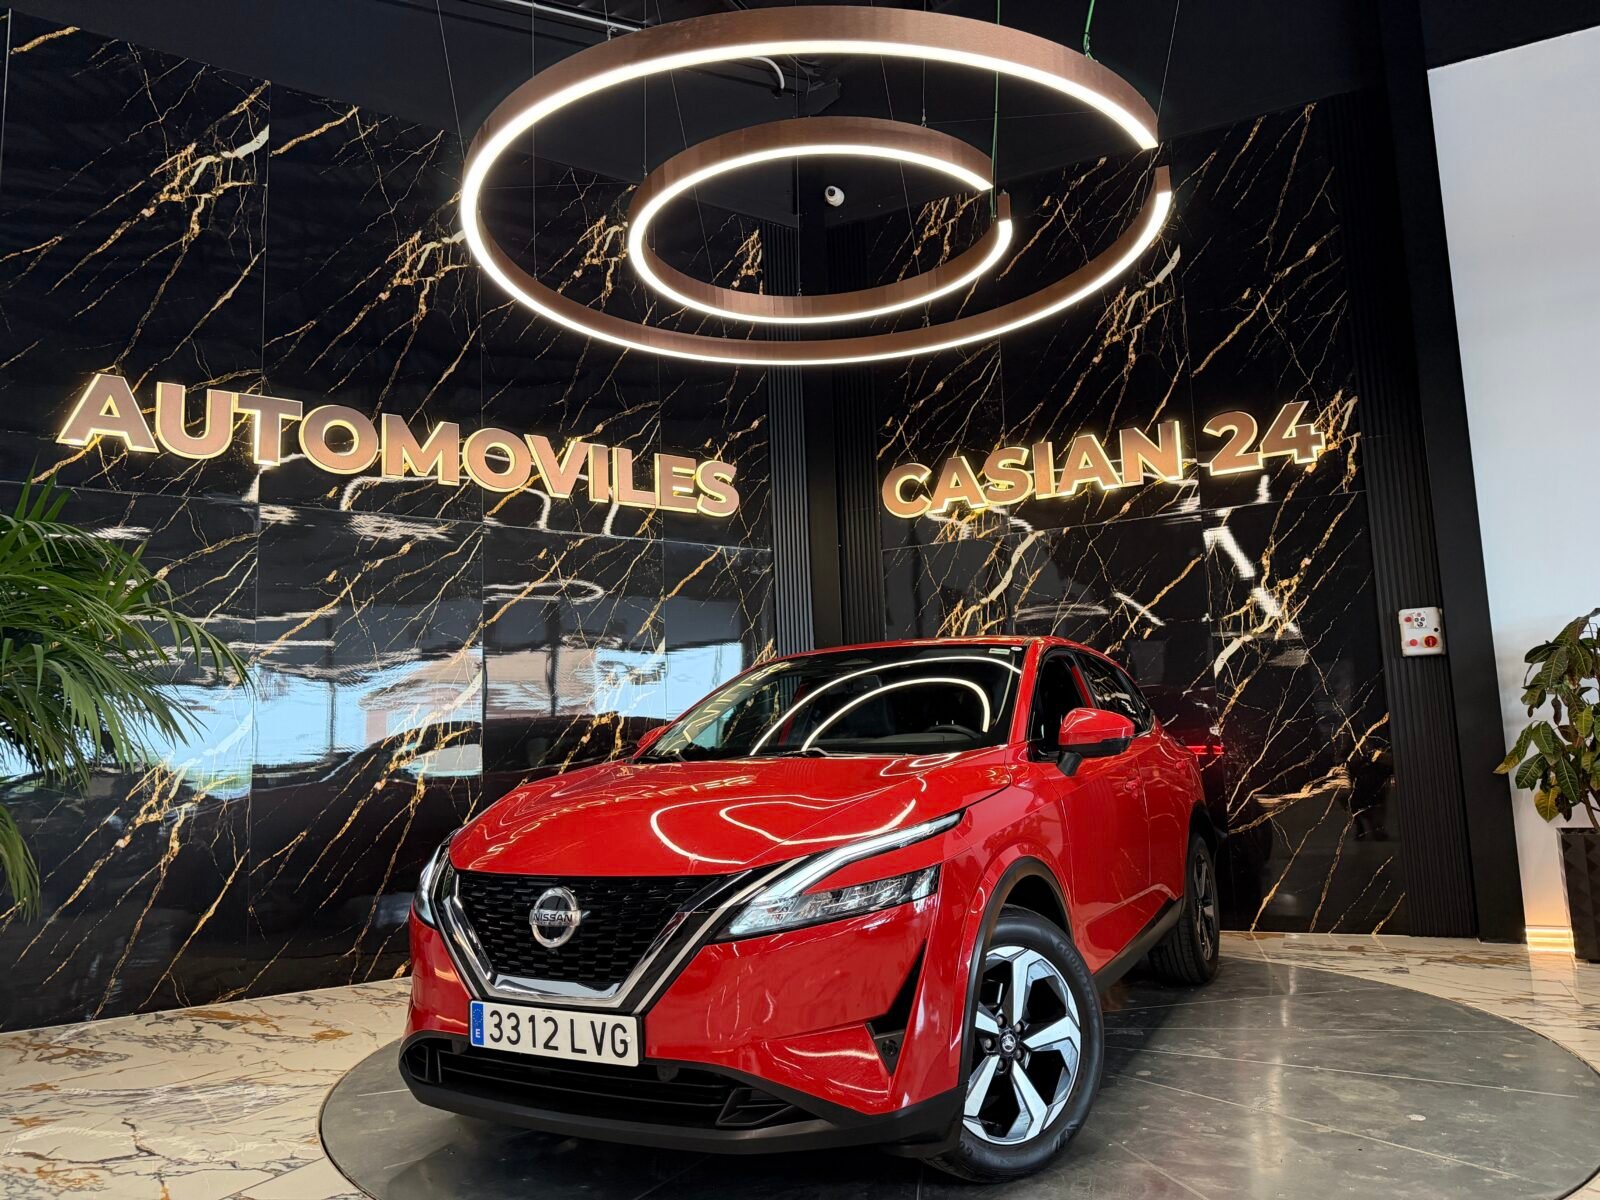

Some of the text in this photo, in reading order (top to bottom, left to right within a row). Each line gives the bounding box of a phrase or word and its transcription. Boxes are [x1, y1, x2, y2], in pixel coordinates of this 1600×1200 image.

[56, 373, 740, 518] AUTOMOVILES
[881, 399, 1327, 519] CASIAN 24
[533, 913, 573, 922] NISSAN
[489, 1010, 629, 1059] 3312 LVG
